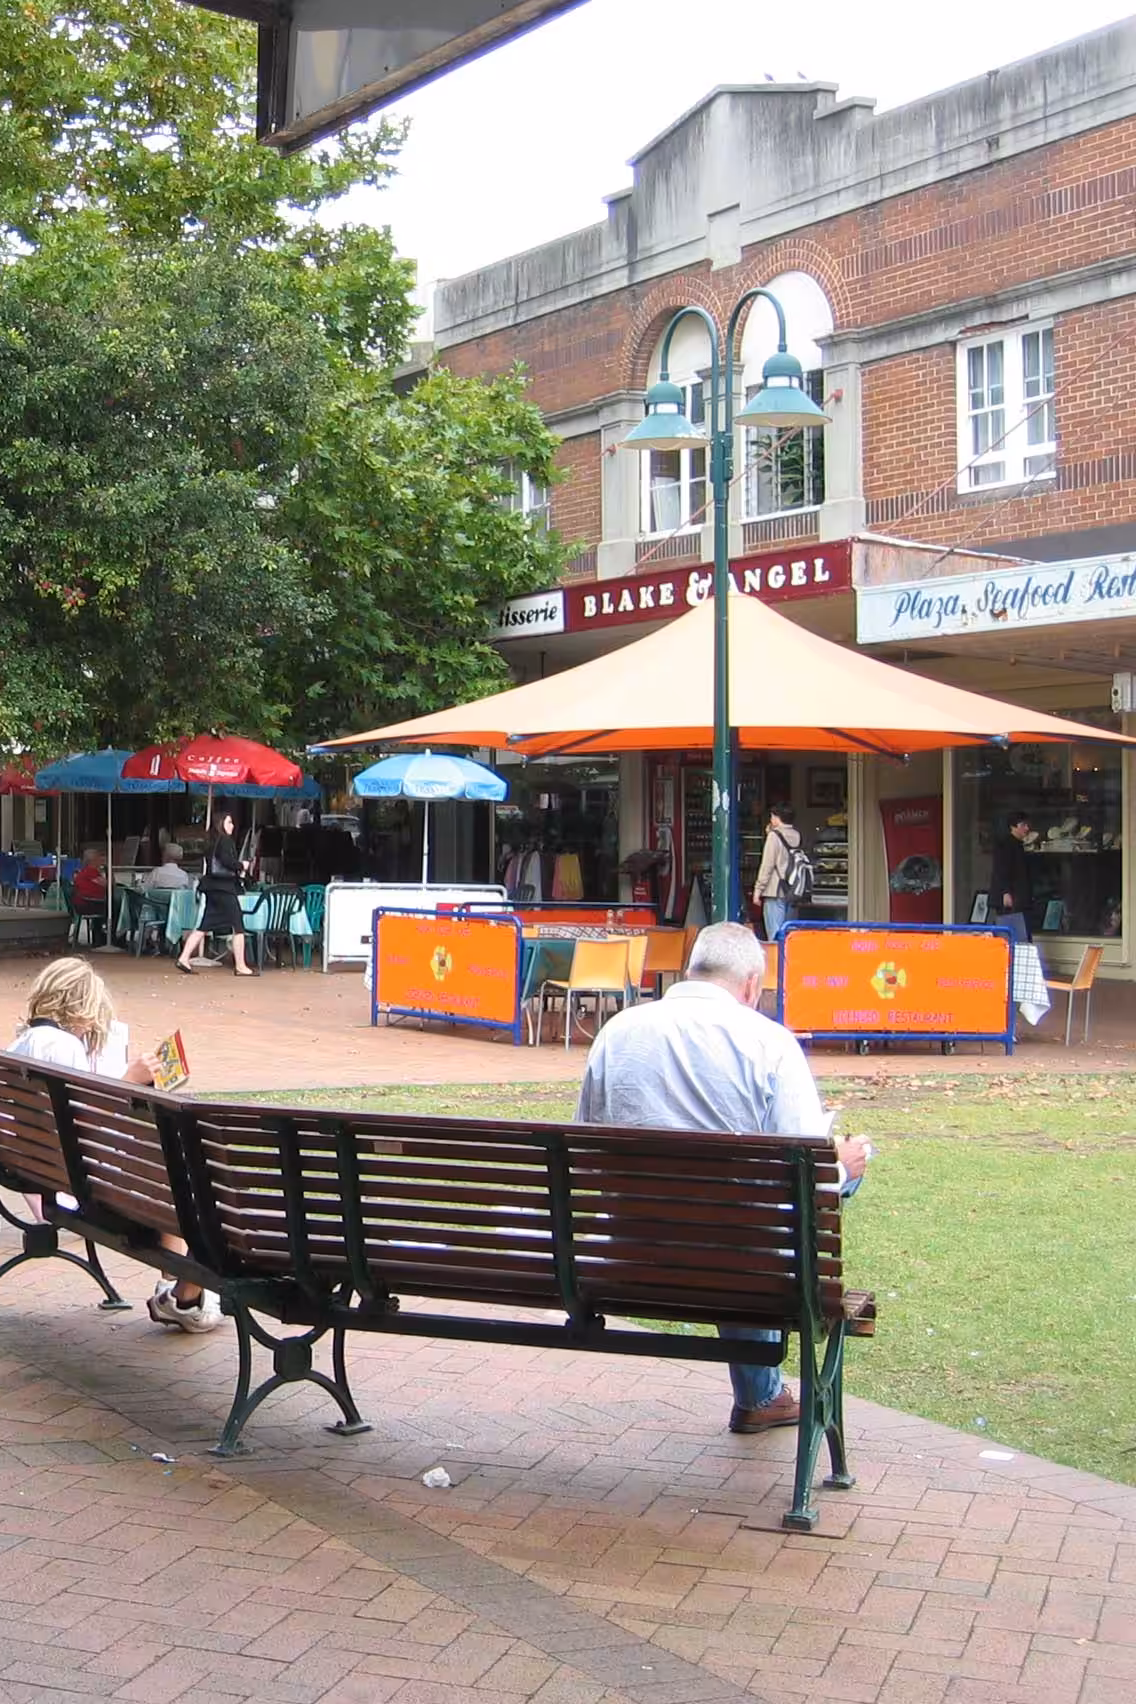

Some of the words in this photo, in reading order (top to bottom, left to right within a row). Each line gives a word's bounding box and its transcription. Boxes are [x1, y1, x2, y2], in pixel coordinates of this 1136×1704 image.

[583, 583, 674, 617] BLAKE
[686, 571, 713, 607] &
[891, 590, 960, 629] Plaza
[976, 570, 1075, 619] Seafood
